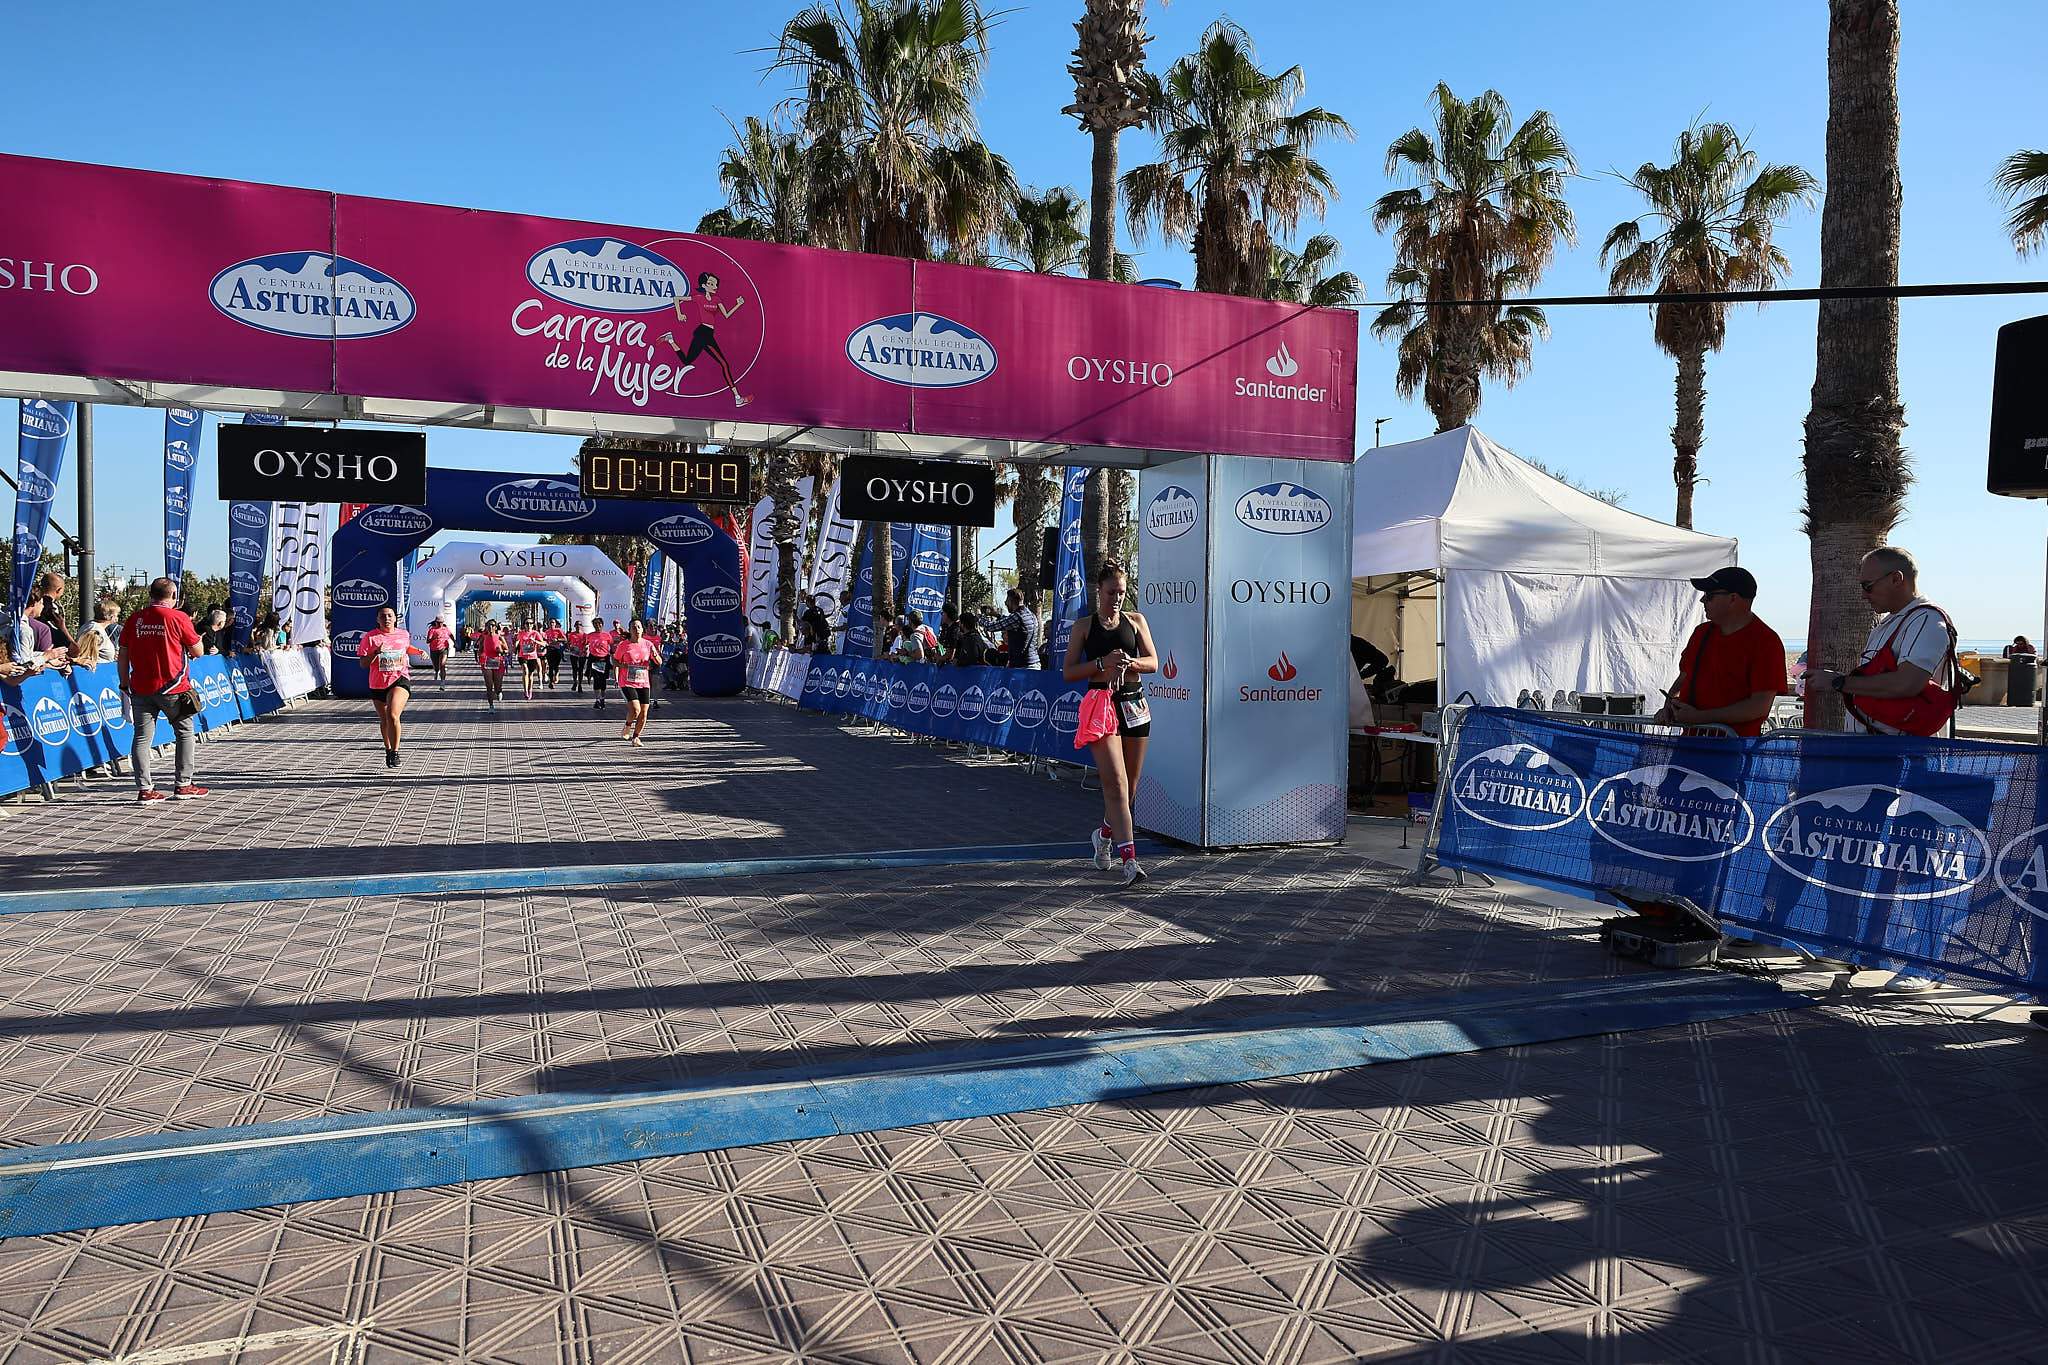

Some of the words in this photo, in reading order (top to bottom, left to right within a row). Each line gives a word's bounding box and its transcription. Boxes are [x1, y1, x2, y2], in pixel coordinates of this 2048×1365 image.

[0, 258, 99, 297] SHO
[538, 257, 677, 299] ASTURIANA
[565, 258, 617, 272] CENTRAL
[621, 264, 673, 278] LECHERA
[258, 277, 324, 291] CENTRAL
[226, 276, 400, 321] ASTURIANA
[511, 299, 647, 347] Carrera
[857, 334, 986, 372] ASTURIANA
[881, 335, 930, 346] CENTRAL
[934, 339, 982, 351] LECHERA
[545, 345, 571, 370] de
[576, 343, 594, 373] la
[589, 344, 696, 407] Mujer
[1067, 355, 1175, 388] OYSHO
[1234, 376, 1327, 402] Santander
[253, 449, 399, 482] OYSHO
[592, 456, 738, 494] 00:40:49
[495, 490, 589, 512] ASTURIANA
[866, 476, 975, 507] OYSHO
[364, 515, 427, 529] ASTURIANA
[1149, 507, 1194, 529] ASTURIANA
[1242, 500, 1325, 523] ASTURIANA
[653, 526, 710, 538] ASTURIANA
[275, 502, 301, 613] OYSH
[295, 502, 321, 615] OYSH
[480, 549, 568, 568] OYSHO
[334, 588, 386, 601] ASTURIANA
[1145, 580, 1197, 605] OYSHO
[1230, 579, 1332, 605] OYSHO
[1148, 681, 1191, 701] Santander
[1239, 685, 1323, 702] Santander
[1459, 767, 1572, 816] ASTURIANA
[1483, 768, 1525, 781] CENTRAL
[1528, 774, 1572, 789] LECHERA
[1594, 788, 1738, 845] ASTURIANA
[1680, 799, 1737, 815] LECHERA
[1813, 815, 1882, 835] CENTRAL
[1888, 824, 1968, 844] LECHERA
[1774, 814, 1968, 881] ASTURIANA
